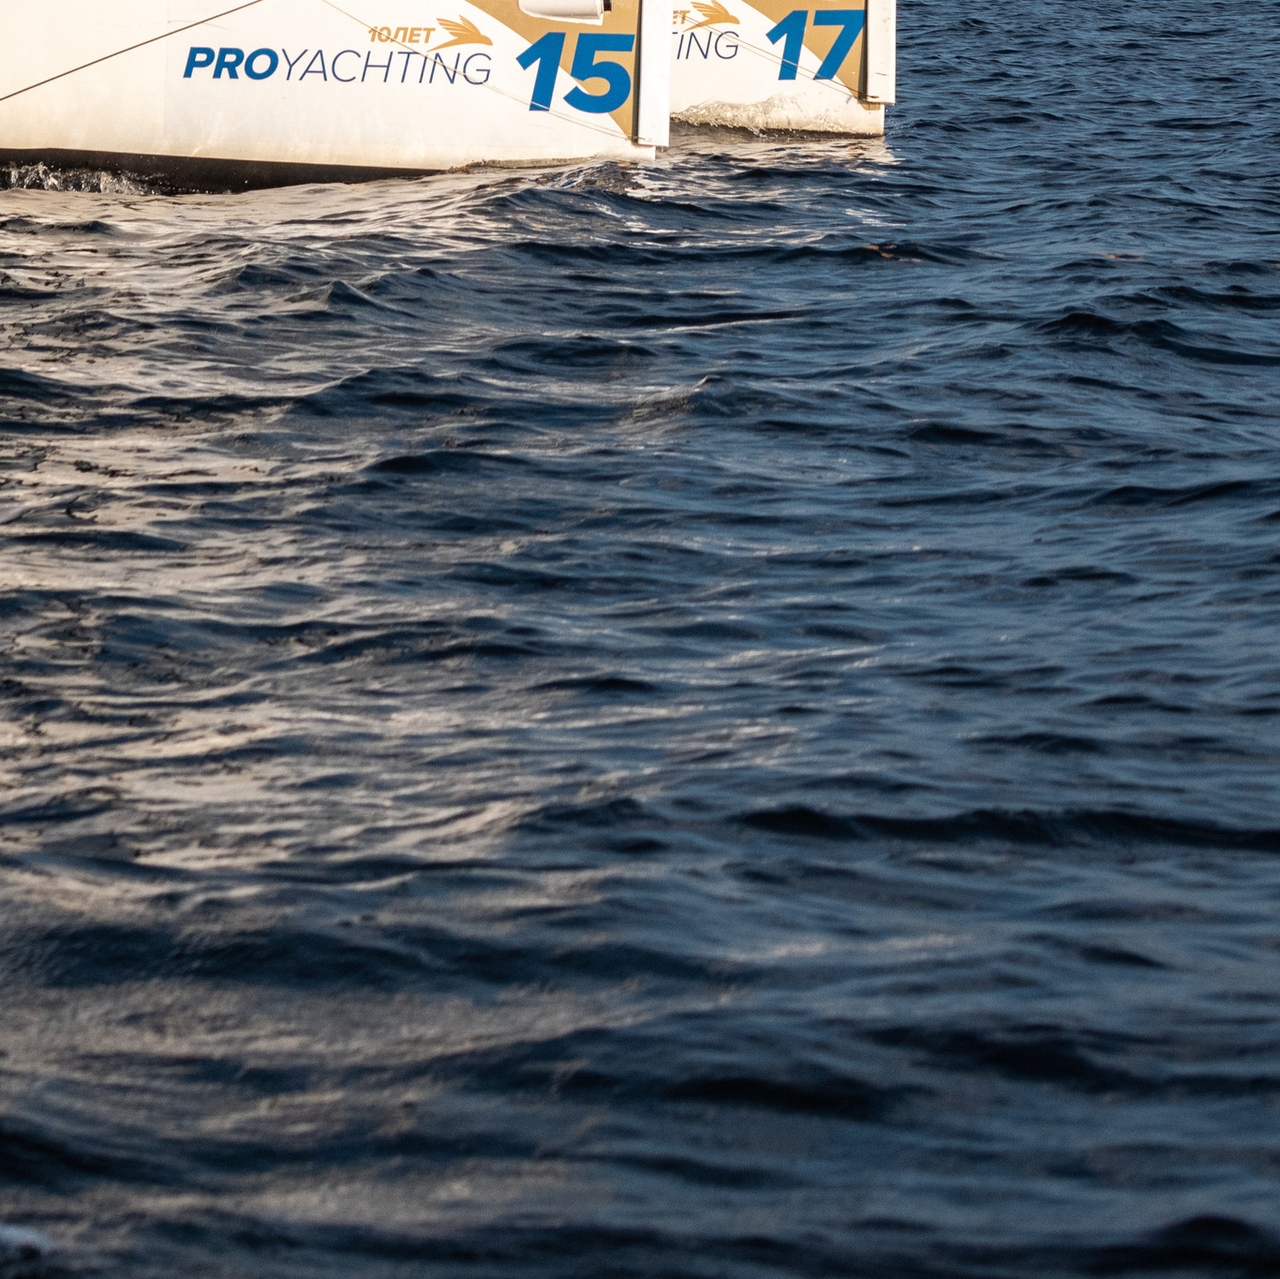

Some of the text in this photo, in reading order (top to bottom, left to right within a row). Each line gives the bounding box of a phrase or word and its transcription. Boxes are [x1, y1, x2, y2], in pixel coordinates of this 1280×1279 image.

[183, 46, 492, 86] PROYACHTING
[516, 32, 636, 114] 15
[766, 9, 867, 80] 17
